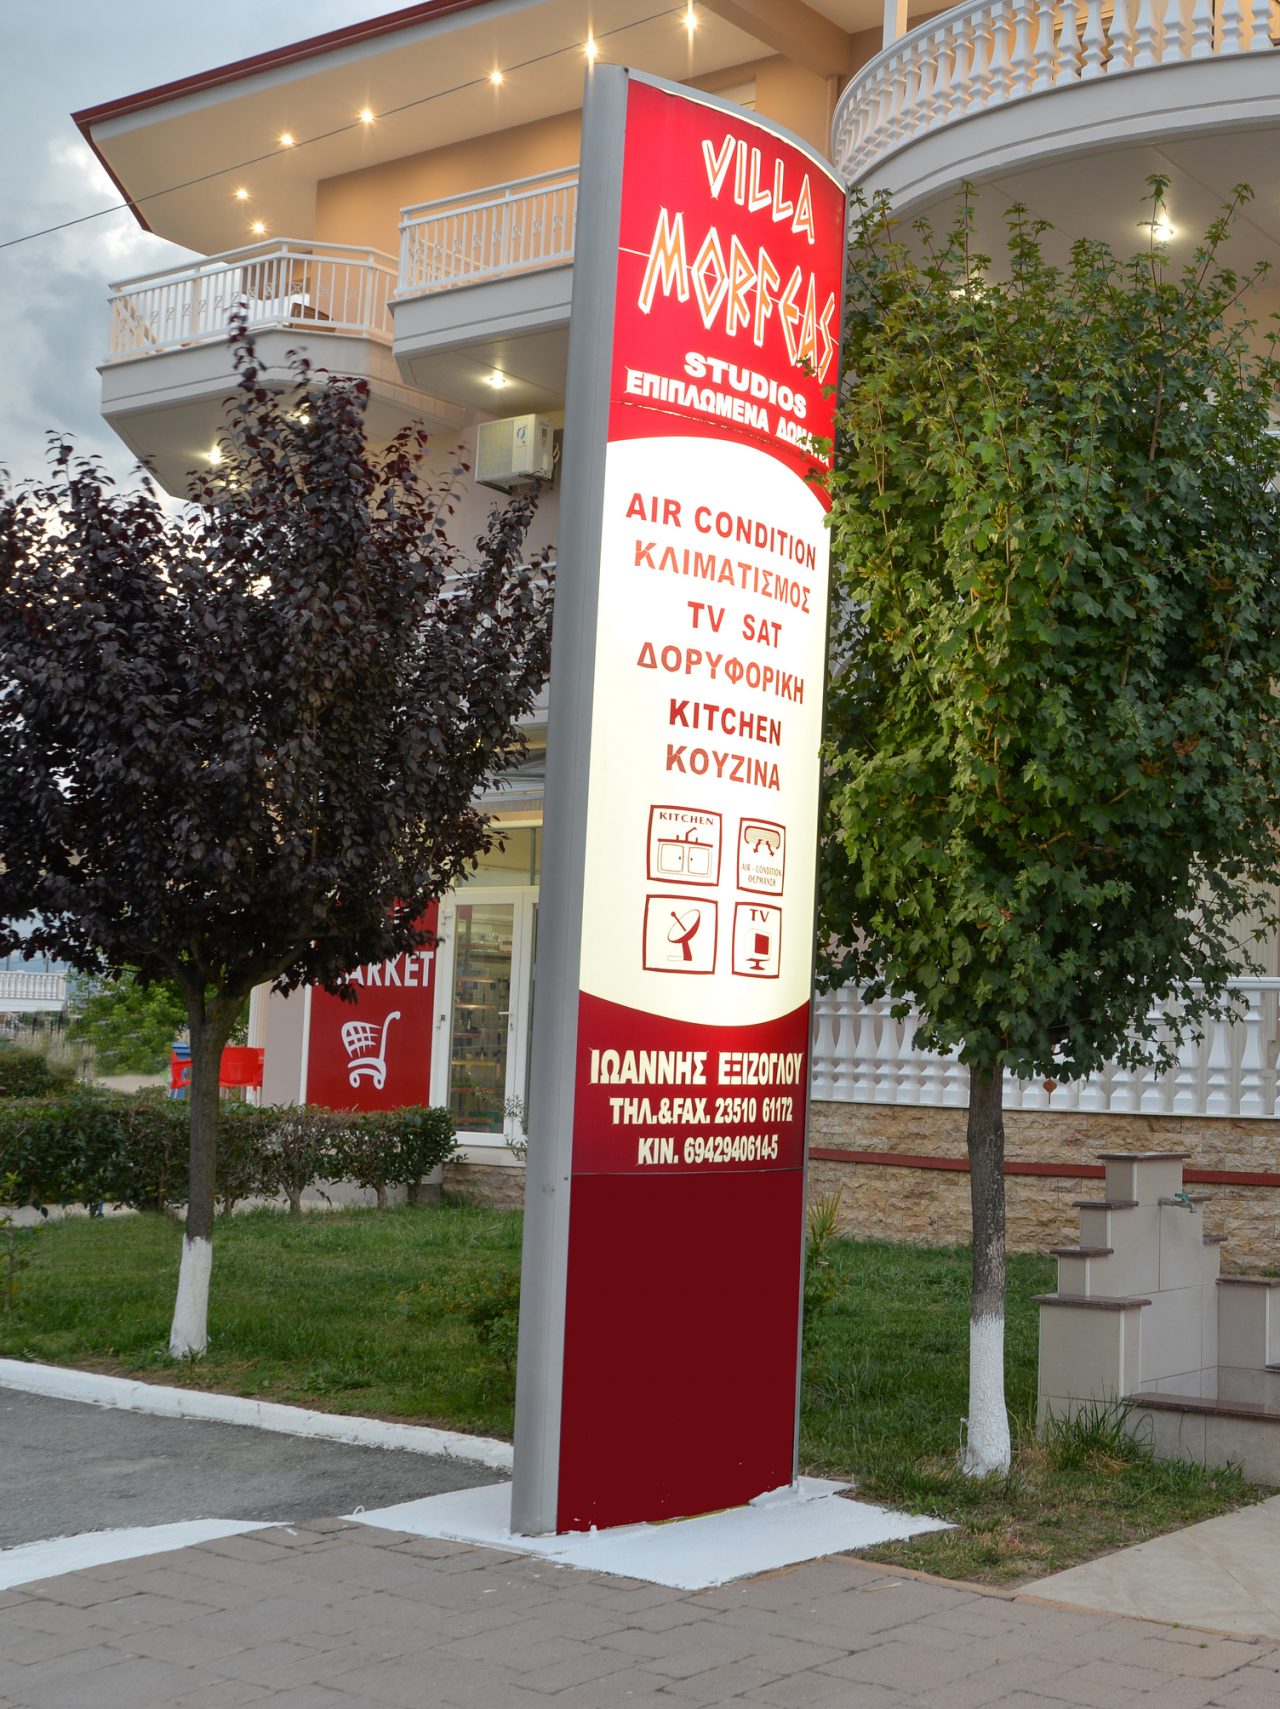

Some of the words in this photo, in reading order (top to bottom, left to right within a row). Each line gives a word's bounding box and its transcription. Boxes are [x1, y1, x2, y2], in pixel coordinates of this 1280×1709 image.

[701, 134, 815, 244] VILLA
[637, 205, 835, 384] MORFEAS
[624, 366, 769, 433] ΕΠΙΠΛΩΜΕΝΑ
[684, 351, 807, 419] STUDIOS
[625, 492, 682, 528] AIR
[694, 506, 817, 571] CONDITION
[634, 539, 811, 614] ΚΛΙΜΑΤΙΣΜΟΣ
[687, 600, 726, 633] TV
[742, 613, 783, 649] SAT
[636, 641, 805, 705] ΔΟΡΥΦΟΡΙΚΗ
[668, 698, 782, 746] KITCHEN
[665, 743, 781, 791] ΚΟΥΖΙΝΑ
[658, 811, 715, 825] KITCHEN
[749, 908, 770, 922] TV
[314, 950, 435, 987] ARKET
[588, 1048, 708, 1086] ΙΩΑΝΝΗΣ
[718, 1051, 803, 1086] ΕΞΙΖΟΓΛΟΥ
[714, 1097, 757, 1124] 23510
[762, 1096, 793, 1123] 61172
